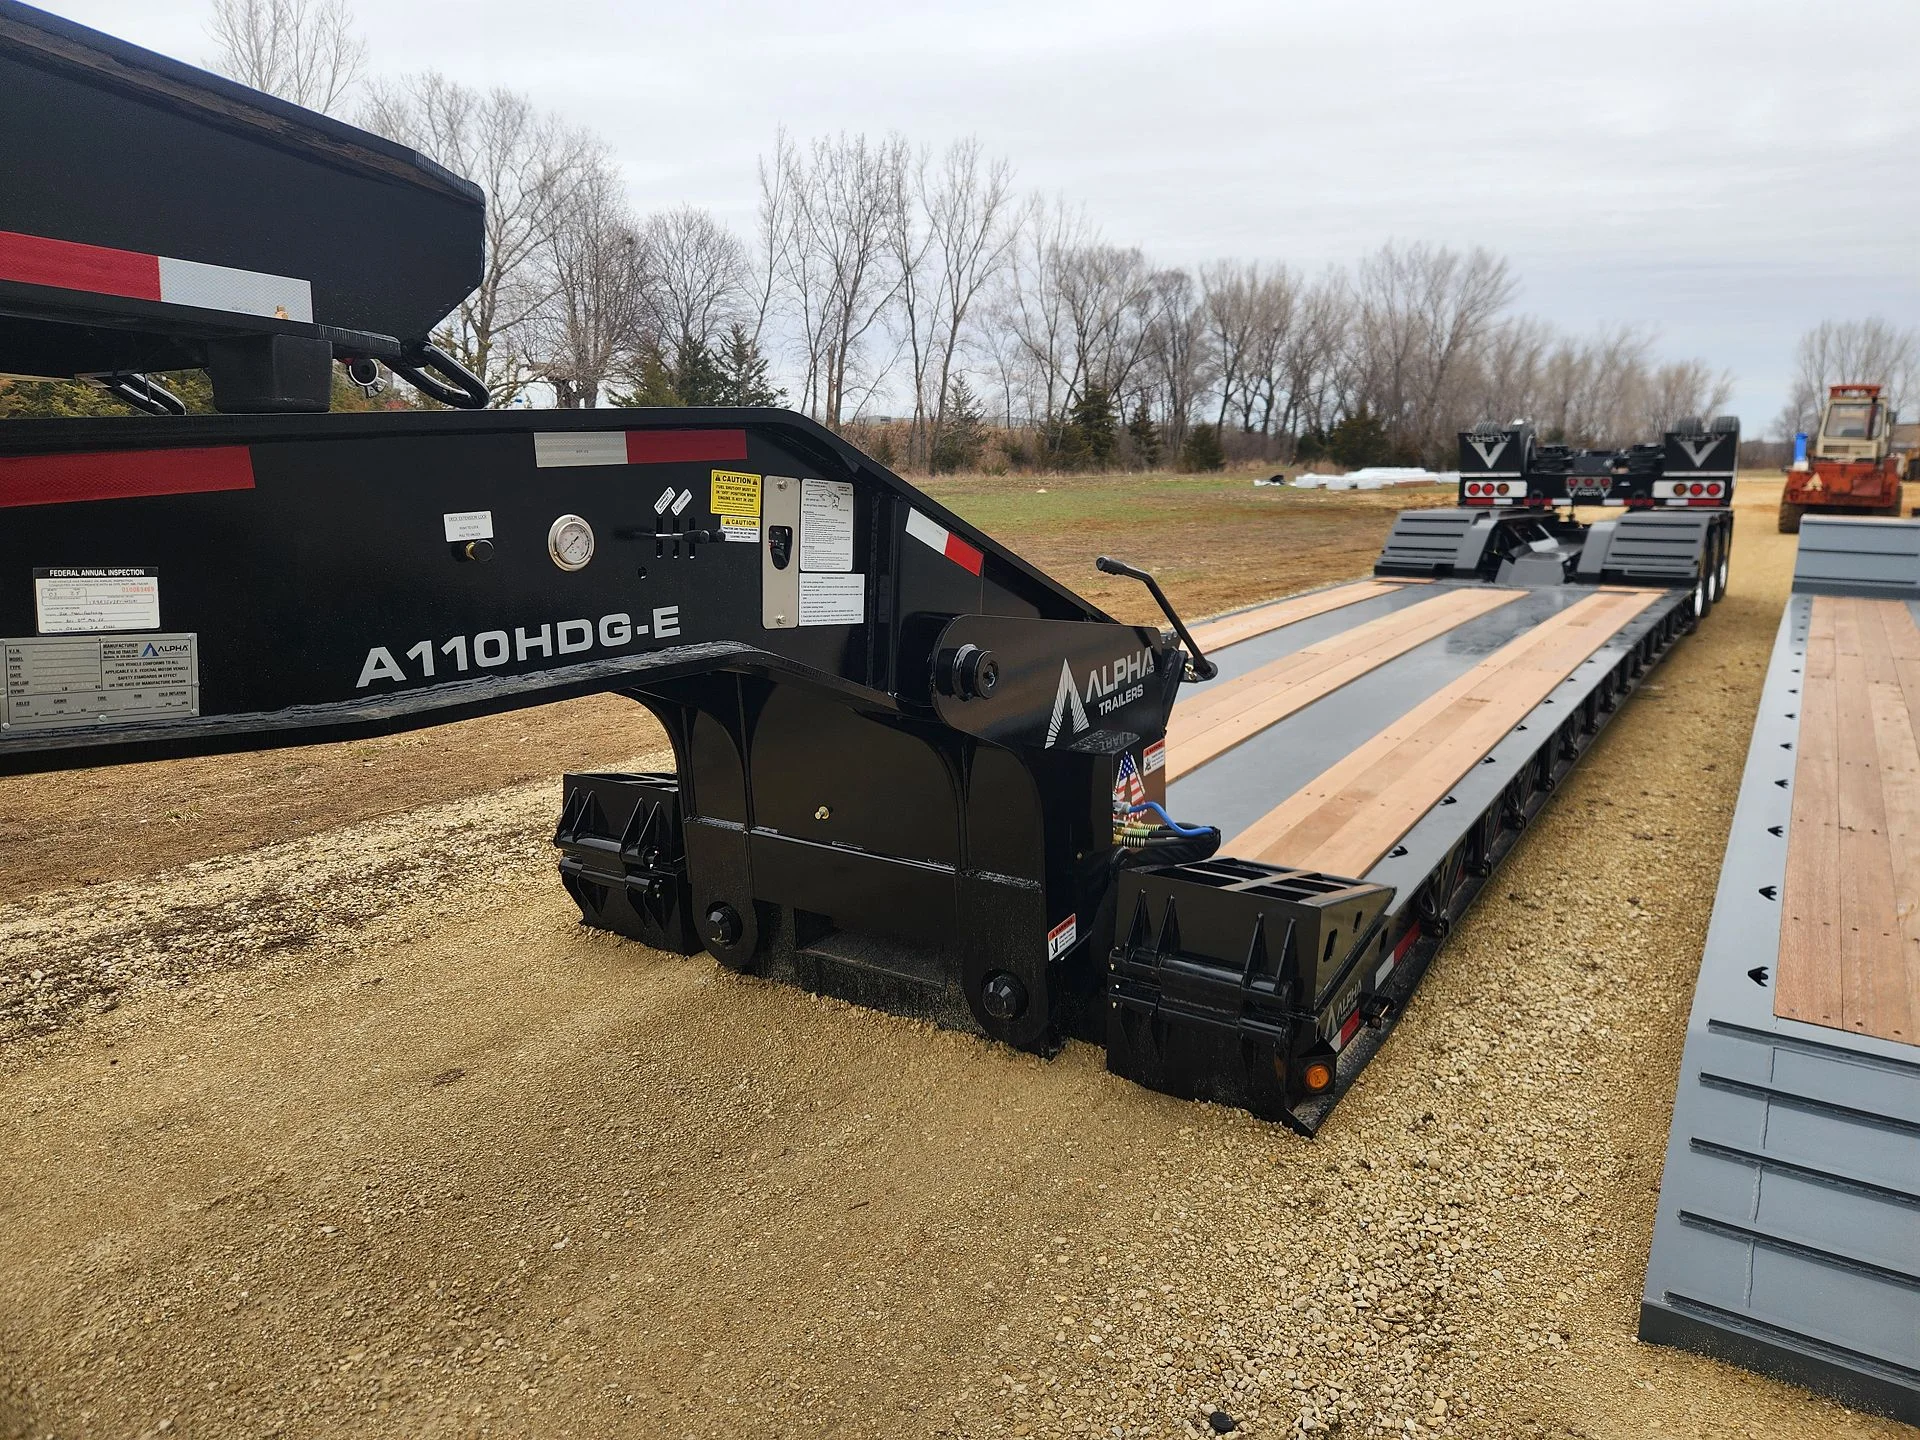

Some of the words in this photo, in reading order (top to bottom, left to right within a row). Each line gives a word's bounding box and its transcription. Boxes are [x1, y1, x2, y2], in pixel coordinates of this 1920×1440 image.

[722, 476, 752, 484] CAUTION
[356, 606, 680, 688] A110HDG-E
[1086, 646, 1154, 703] ALPHA
[1099, 684, 1143, 716] TRAILERS
[1337, 980, 1361, 1020] ALPHA
